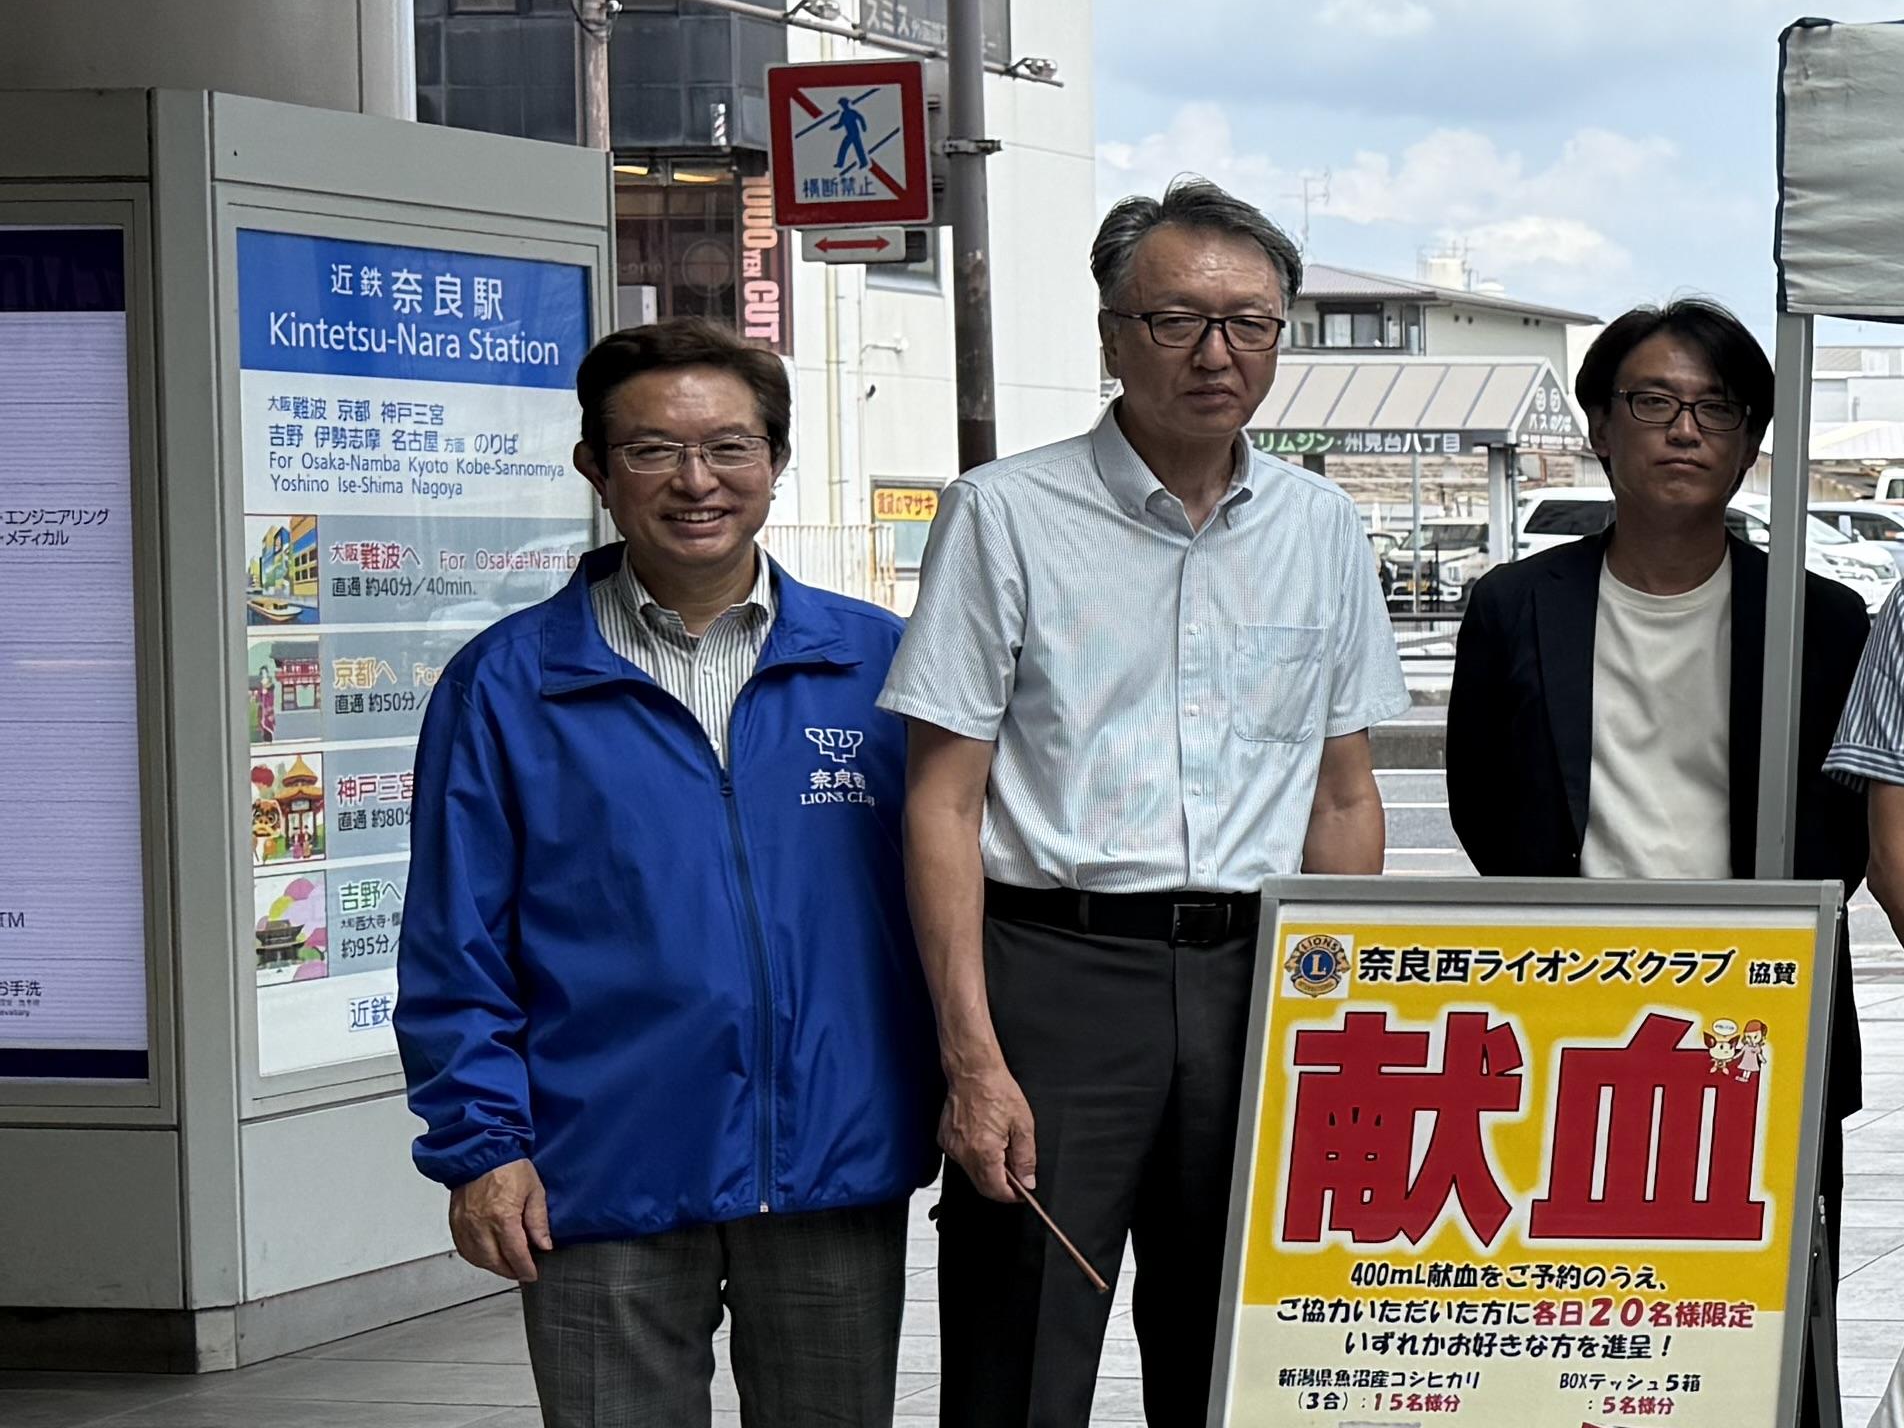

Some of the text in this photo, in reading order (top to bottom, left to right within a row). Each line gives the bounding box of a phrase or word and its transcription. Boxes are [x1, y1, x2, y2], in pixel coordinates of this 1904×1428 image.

[802, 176, 877, 199] 横断禁止
[743, 249, 762, 277] YEN
[331, 263, 504, 321] 近鉄 奈良駅
[744, 280, 780, 343] CUT
[269, 311, 559, 365] Kintetsu-Nara Station
[268, 396, 444, 426] 大阪難波 京都 神戸三宮
[269, 423, 303, 449] 吉野
[314, 425, 380, 451] 伊勢志摩
[391, 429, 439, 453] 名古屋
[474, 433, 518, 455] のりば
[269, 452, 565, 482] For Osaka-Namba Kyoto Kobe-Sannomiya
[271, 474, 463, 499] Yoshino Ise-Shima Nagoya
[331, 542, 421, 571] 大阪難波へ
[440, 550, 465, 571] For
[332, 577, 361, 597] 直通
[333, 658, 396, 690] 京都へ
[335, 694, 364, 715] 直通
[810, 768, 866, 790] 奈良西
[800, 791, 845, 805] LIONS
[338, 810, 366, 831] 直通
[340, 880, 401, 910] 吉野へ
[1300, 937, 1340, 952] LIONS
[1310, 953, 1327, 976] L
[1359, 948, 1736, 986] 奈良西ライオンズクラブ
[1748, 961, 1797, 987] 協賛
[350, 996, 392, 1029] 近鉄
[1282, 1011, 1766, 1248] 献血
[1350, 1263, 1667, 1291] 400mL献血をご予約のうえ、
[1276, 1298, 1755, 1330] ご協力いただいた方に各日20名様限定
[1344, 1333, 1671, 1360] いずれかお好きな方を進呈！
[1278, 1369, 1480, 1391] 新潟県魚沼産コシヒカリ
